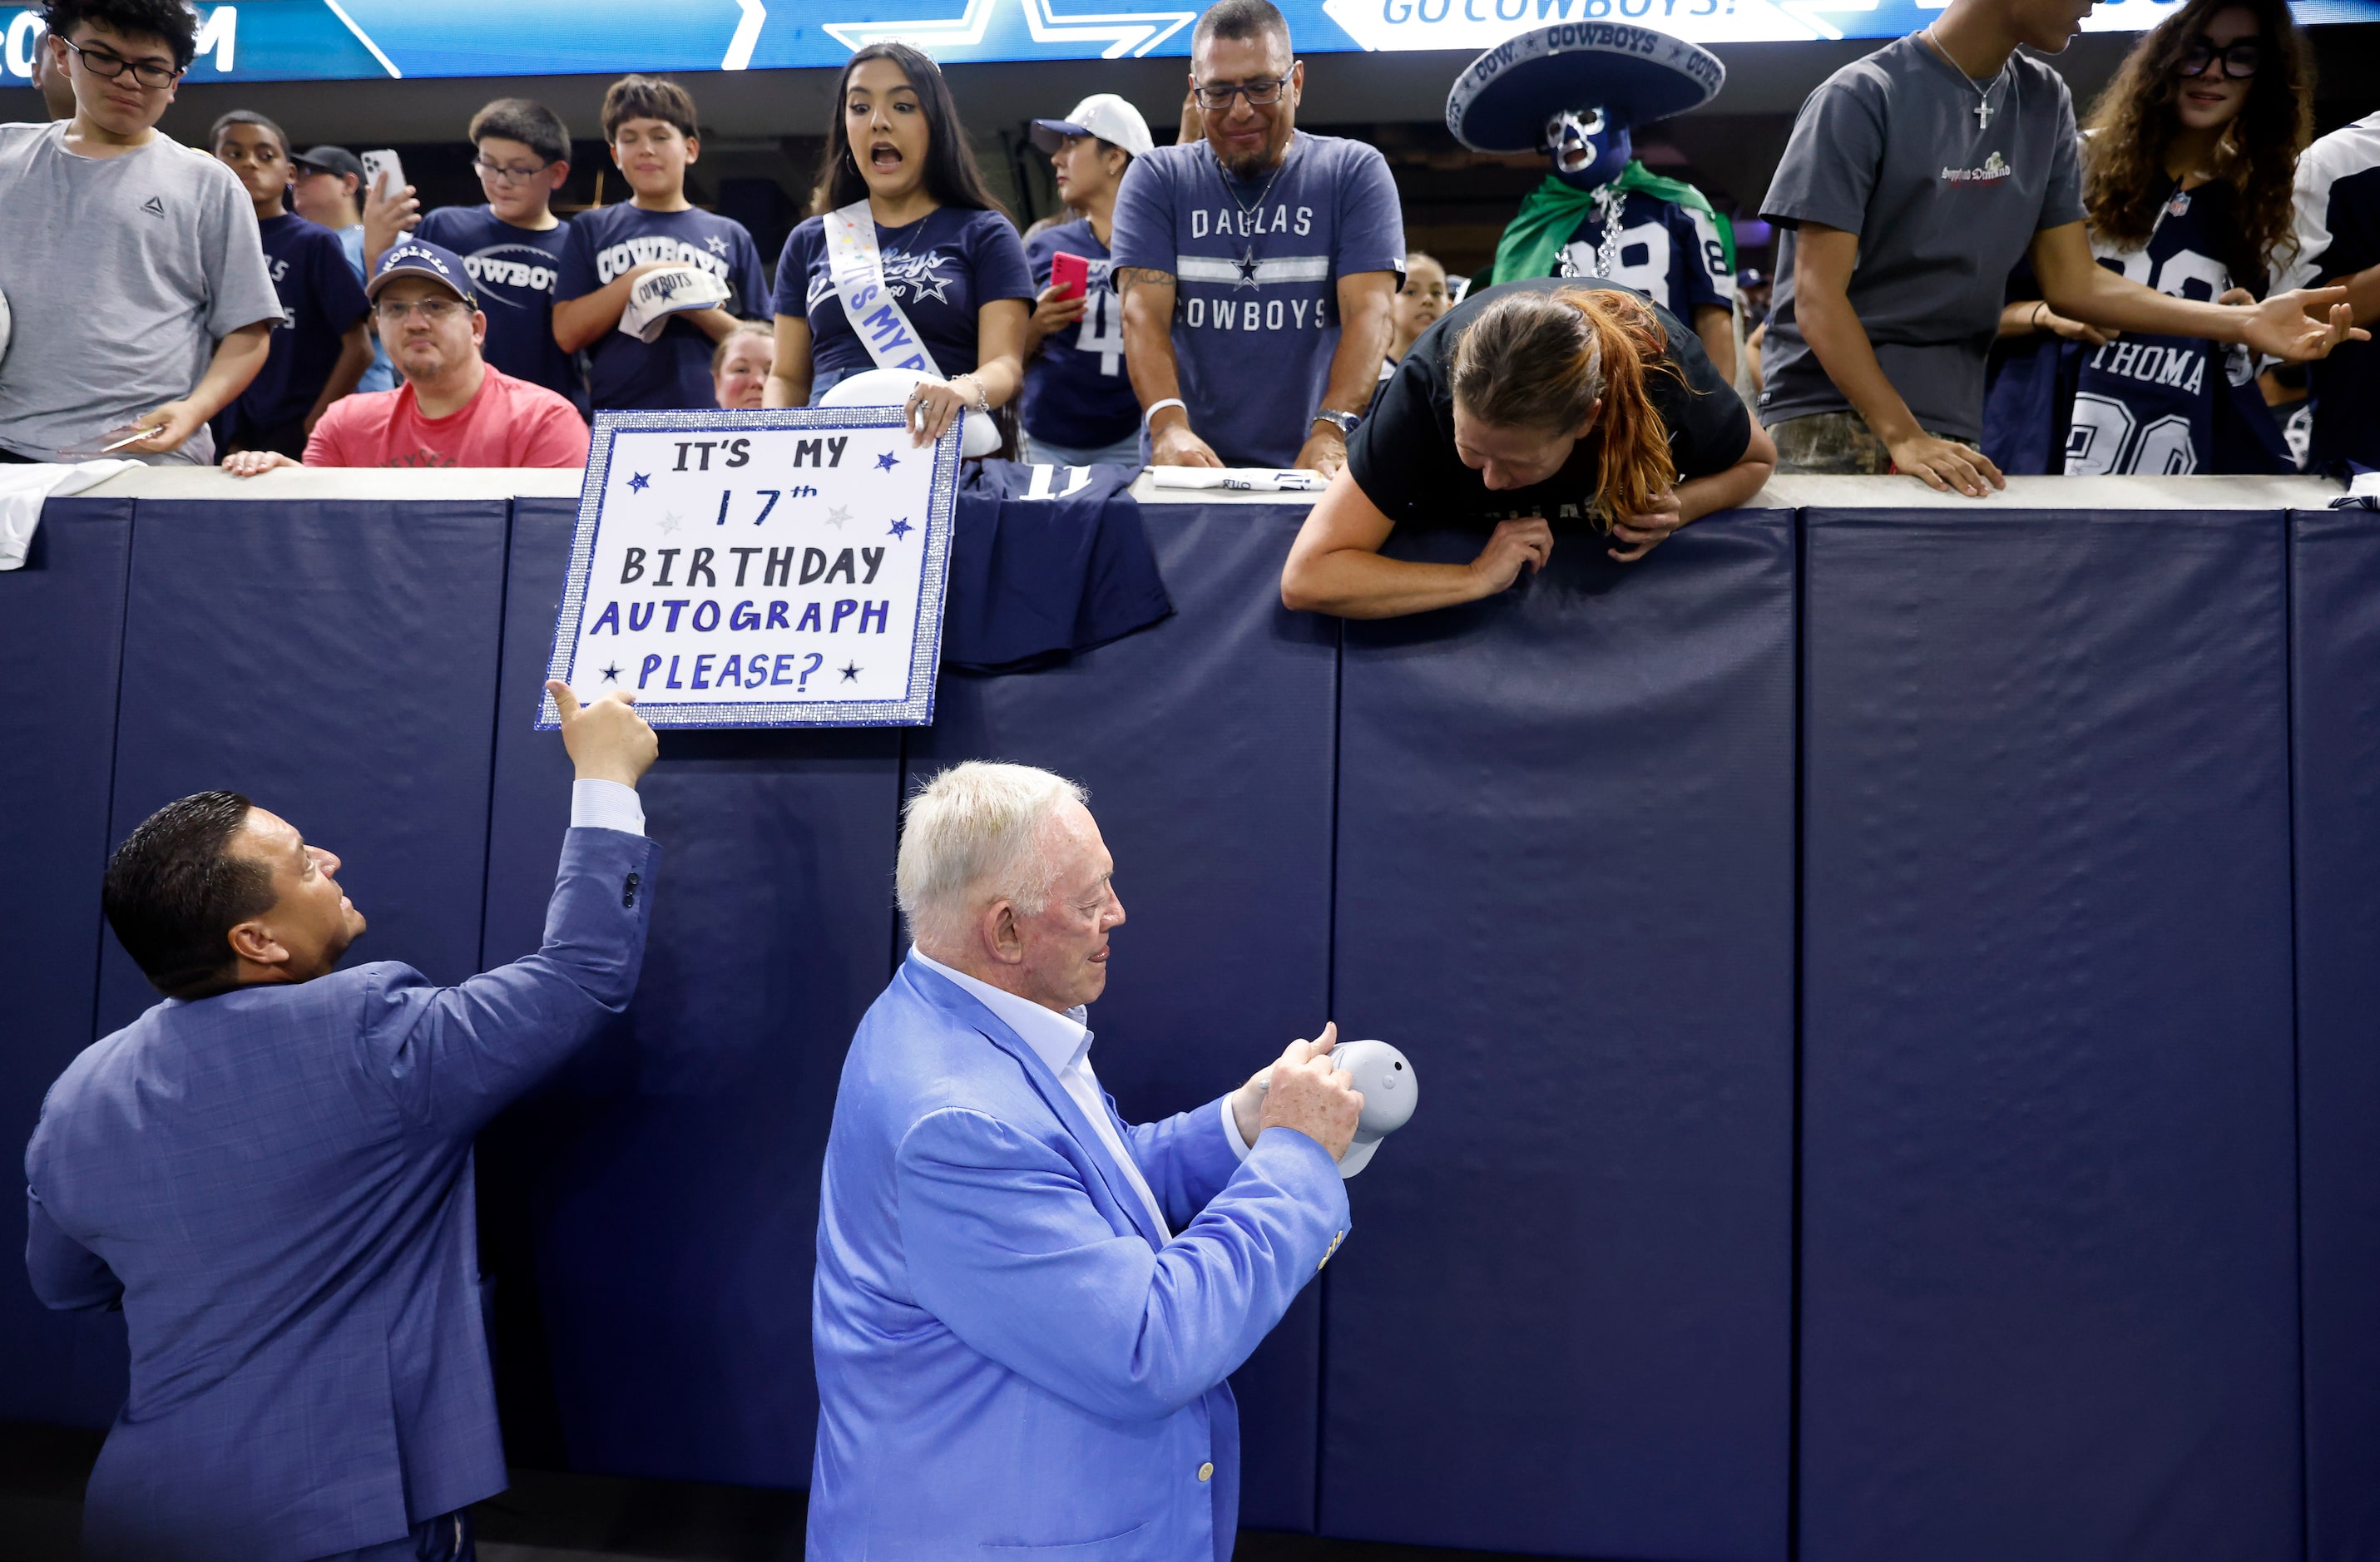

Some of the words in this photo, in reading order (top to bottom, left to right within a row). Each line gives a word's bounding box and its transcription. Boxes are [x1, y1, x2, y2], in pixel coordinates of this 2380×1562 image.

[1547, 23, 1659, 55] COWBOYS
[1191, 205, 1313, 239] DALLAS
[639, 272, 692, 304] COWBOYS
[841, 264, 879, 311] IT'S
[862, 304, 913, 354] MY
[672, 438, 751, 472] IT'S
[793, 436, 849, 468] MY
[621, 546, 886, 588] BIRTHDAY
[590, 598, 889, 636] AUTOGRAPH
[638, 652, 824, 693] PLEASE?
